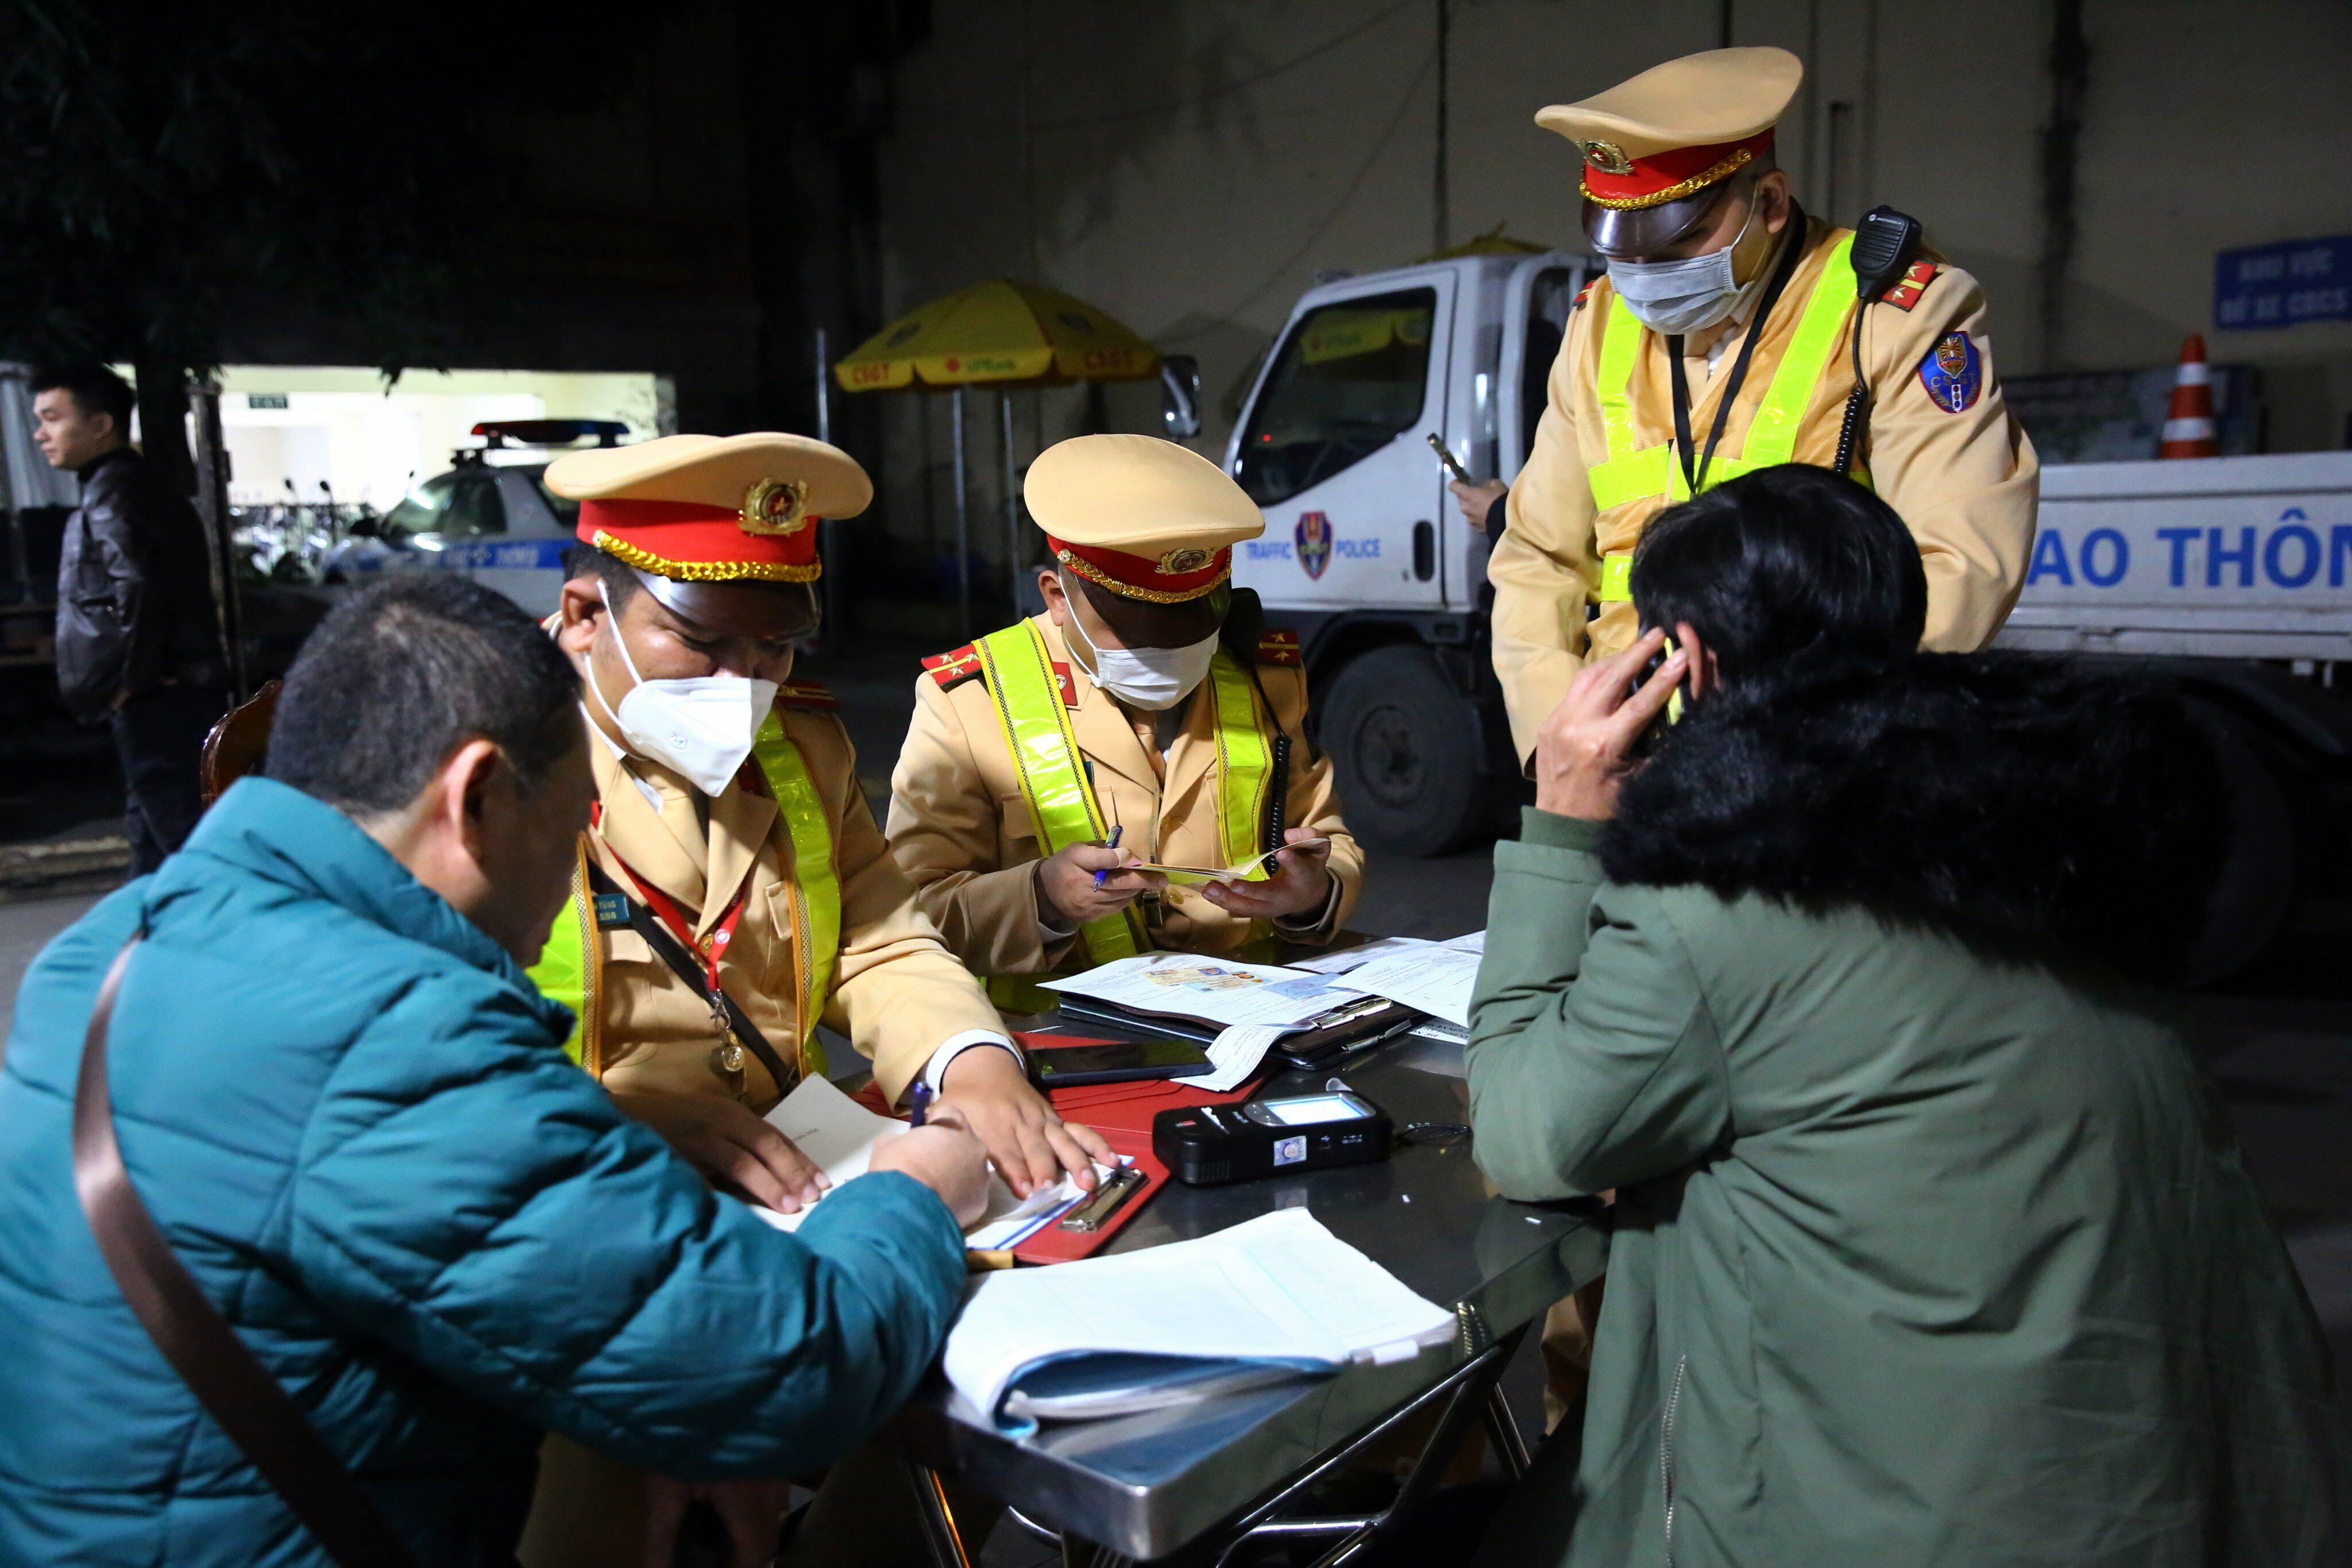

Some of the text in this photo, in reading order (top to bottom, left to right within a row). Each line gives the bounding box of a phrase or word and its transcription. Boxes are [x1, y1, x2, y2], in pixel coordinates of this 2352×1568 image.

[1246, 542, 1291, 560] TRAFFIC
[1334, 538, 1381, 558] POLICE
[2026, 507, 2352, 588] AO THÔ
